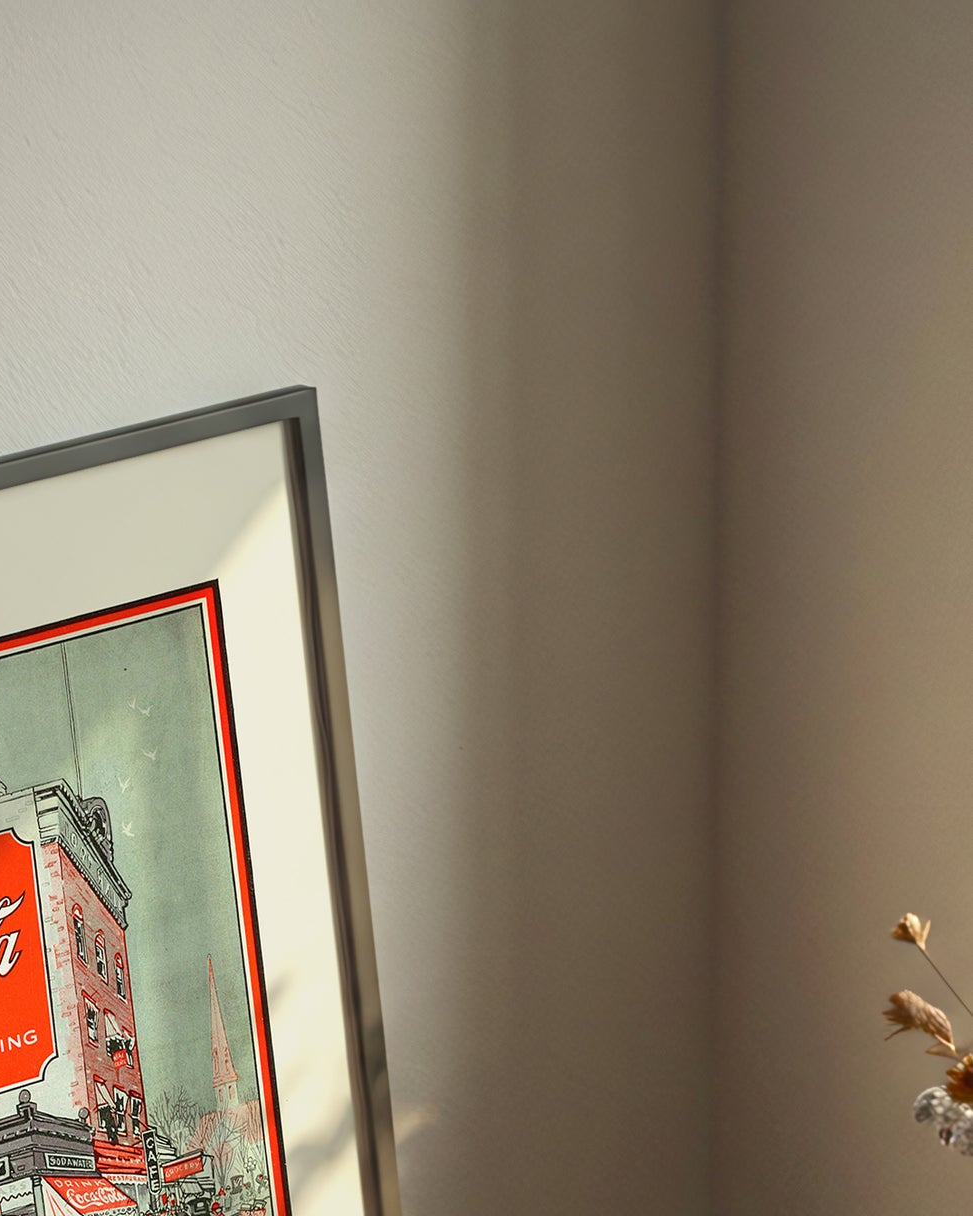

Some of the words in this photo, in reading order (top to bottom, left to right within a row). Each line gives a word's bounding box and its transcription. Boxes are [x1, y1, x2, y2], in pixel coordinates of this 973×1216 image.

[146, 1137, 159, 1191] CAFE
[165, 1161, 200, 1177] GROCERY
[53, 1179, 106, 1188] DRINK
